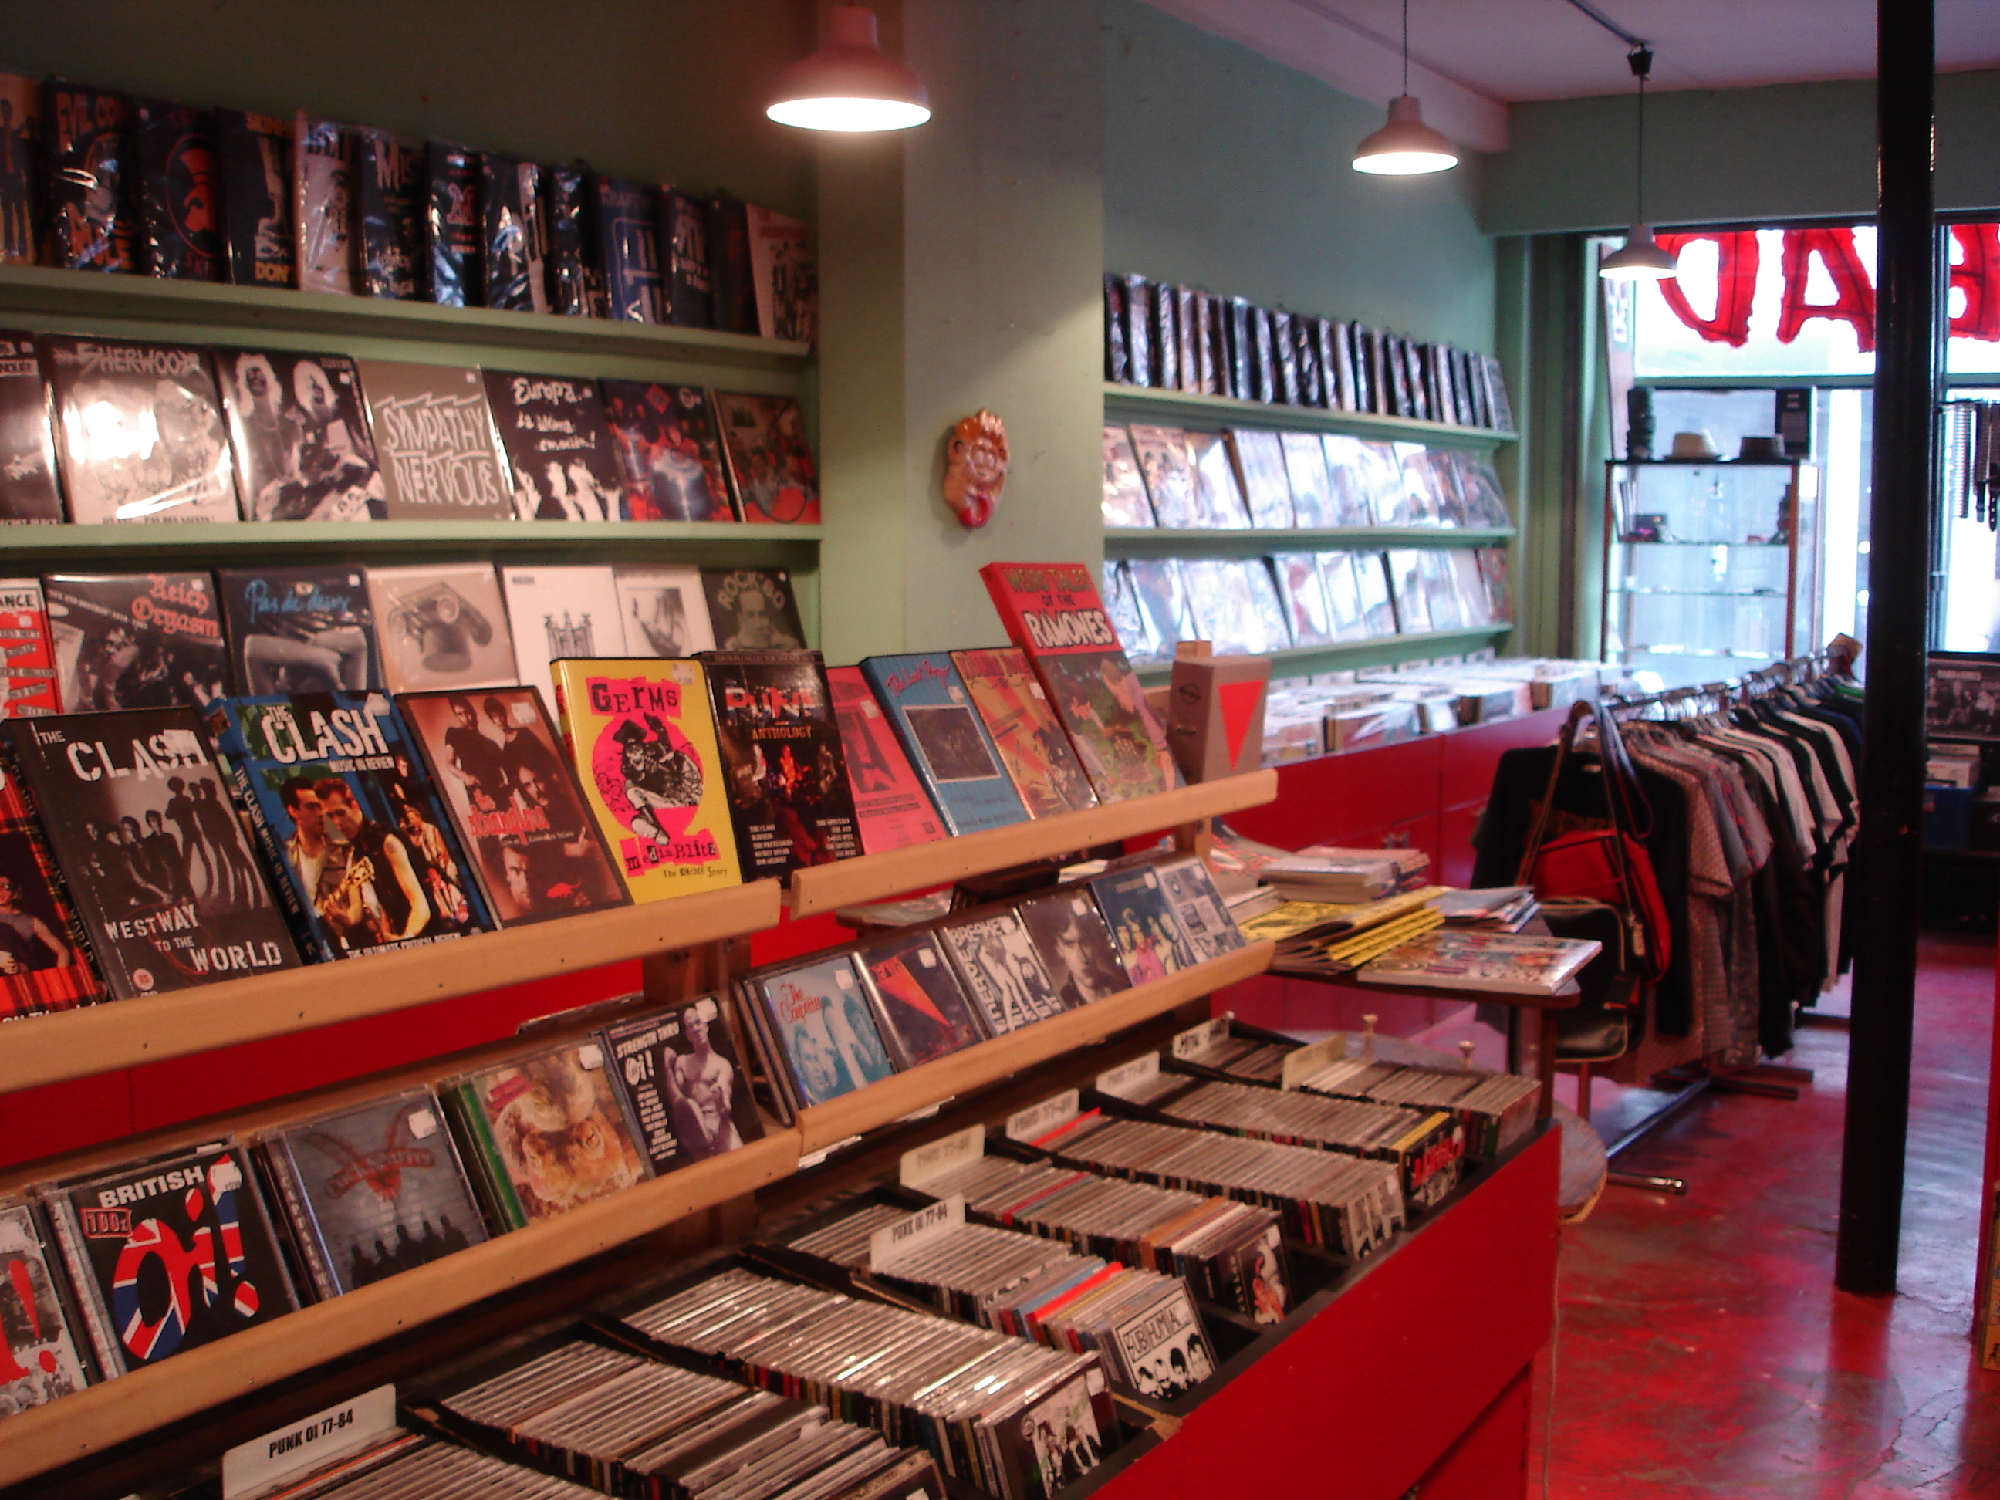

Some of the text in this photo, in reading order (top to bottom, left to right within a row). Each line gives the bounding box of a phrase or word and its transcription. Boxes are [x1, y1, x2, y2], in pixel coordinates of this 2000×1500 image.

[383, 406, 486, 451] SYMPATHY
[393, 457, 499, 506] NERVOUS
[0, 593, 35, 607] NCE
[132, 596, 219, 638] Orgasm
[1022, 608, 1113, 649] RAMONES
[39, 730, 67, 744] THE
[261, 708, 389, 764] CLASH
[752, 725, 812, 739] ANTHOLOGY
[103, 903, 198, 942] WESTWAY
[155, 936, 195, 952] TO THE
[189, 940, 283, 972] WORLD
[98, 1166, 206, 1210] BRITISH
[269, 1430, 303, 1459] PUNK
[322, 1408, 354, 1436] 77-84
